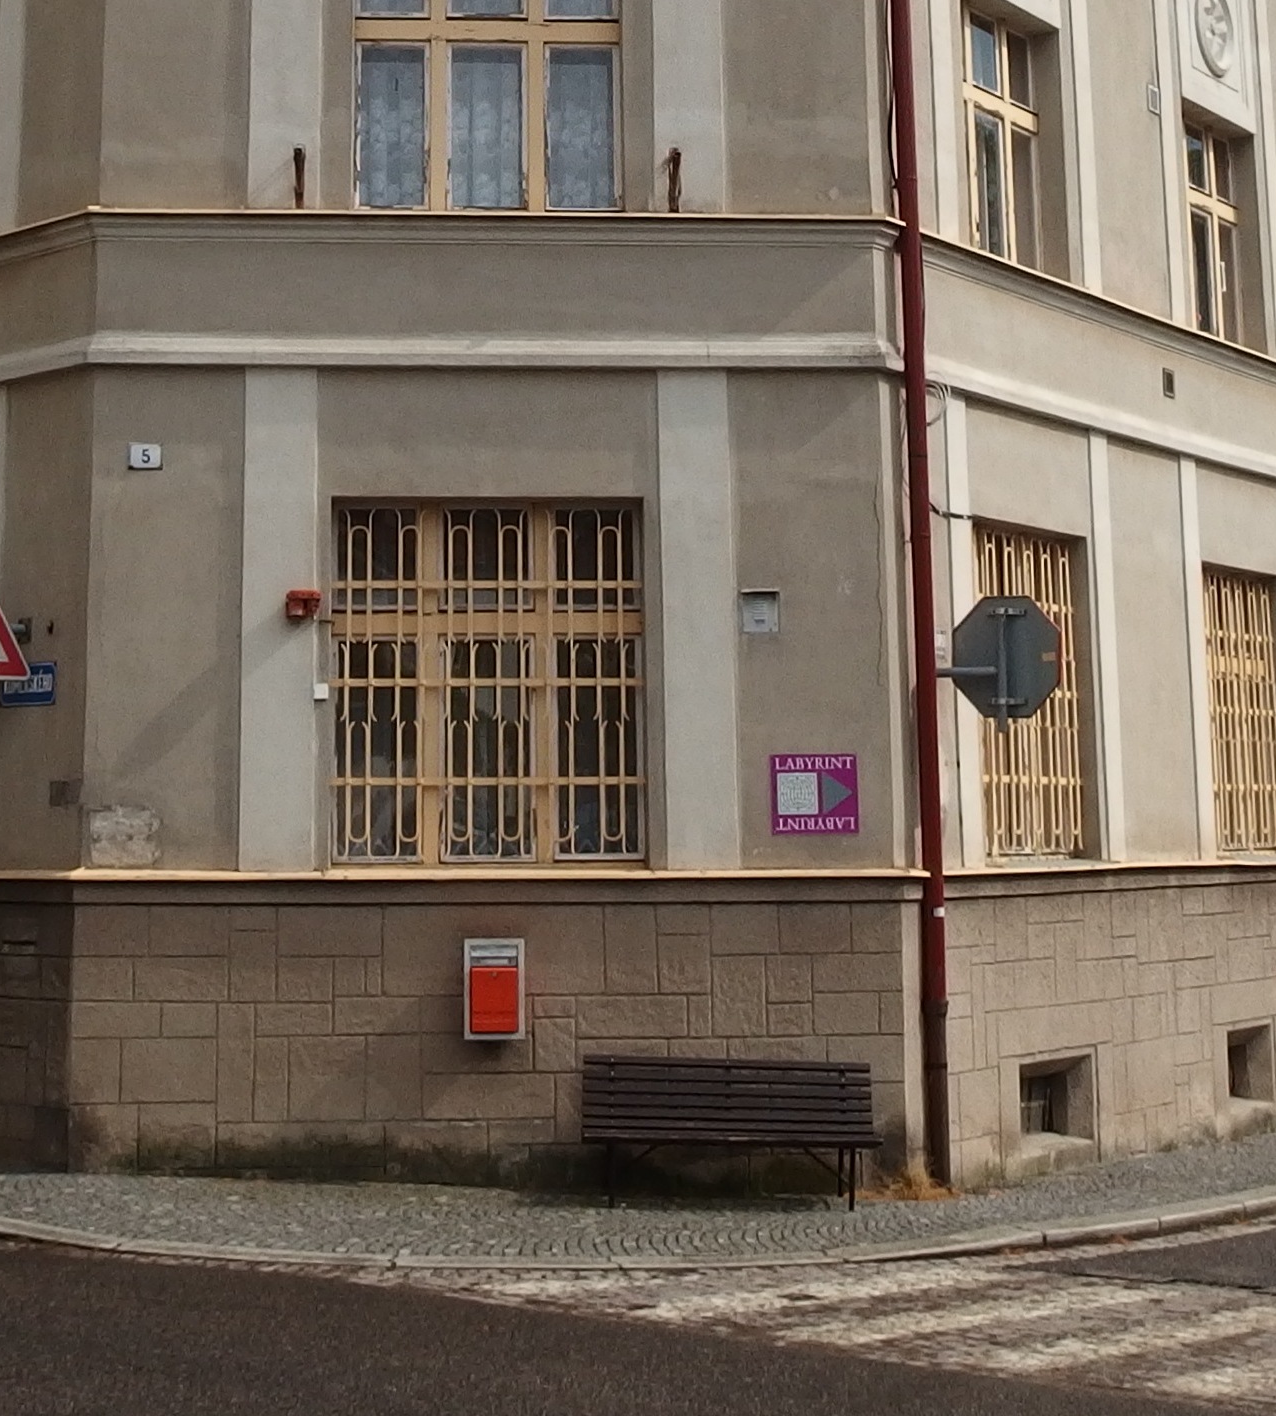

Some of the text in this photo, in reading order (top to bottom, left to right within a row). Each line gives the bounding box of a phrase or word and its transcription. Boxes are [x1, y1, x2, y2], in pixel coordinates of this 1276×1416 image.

[141, 448, 151, 464] 5
[774, 756, 855, 771] LABYRINT
[776, 816, 855, 831] LABYRINT
